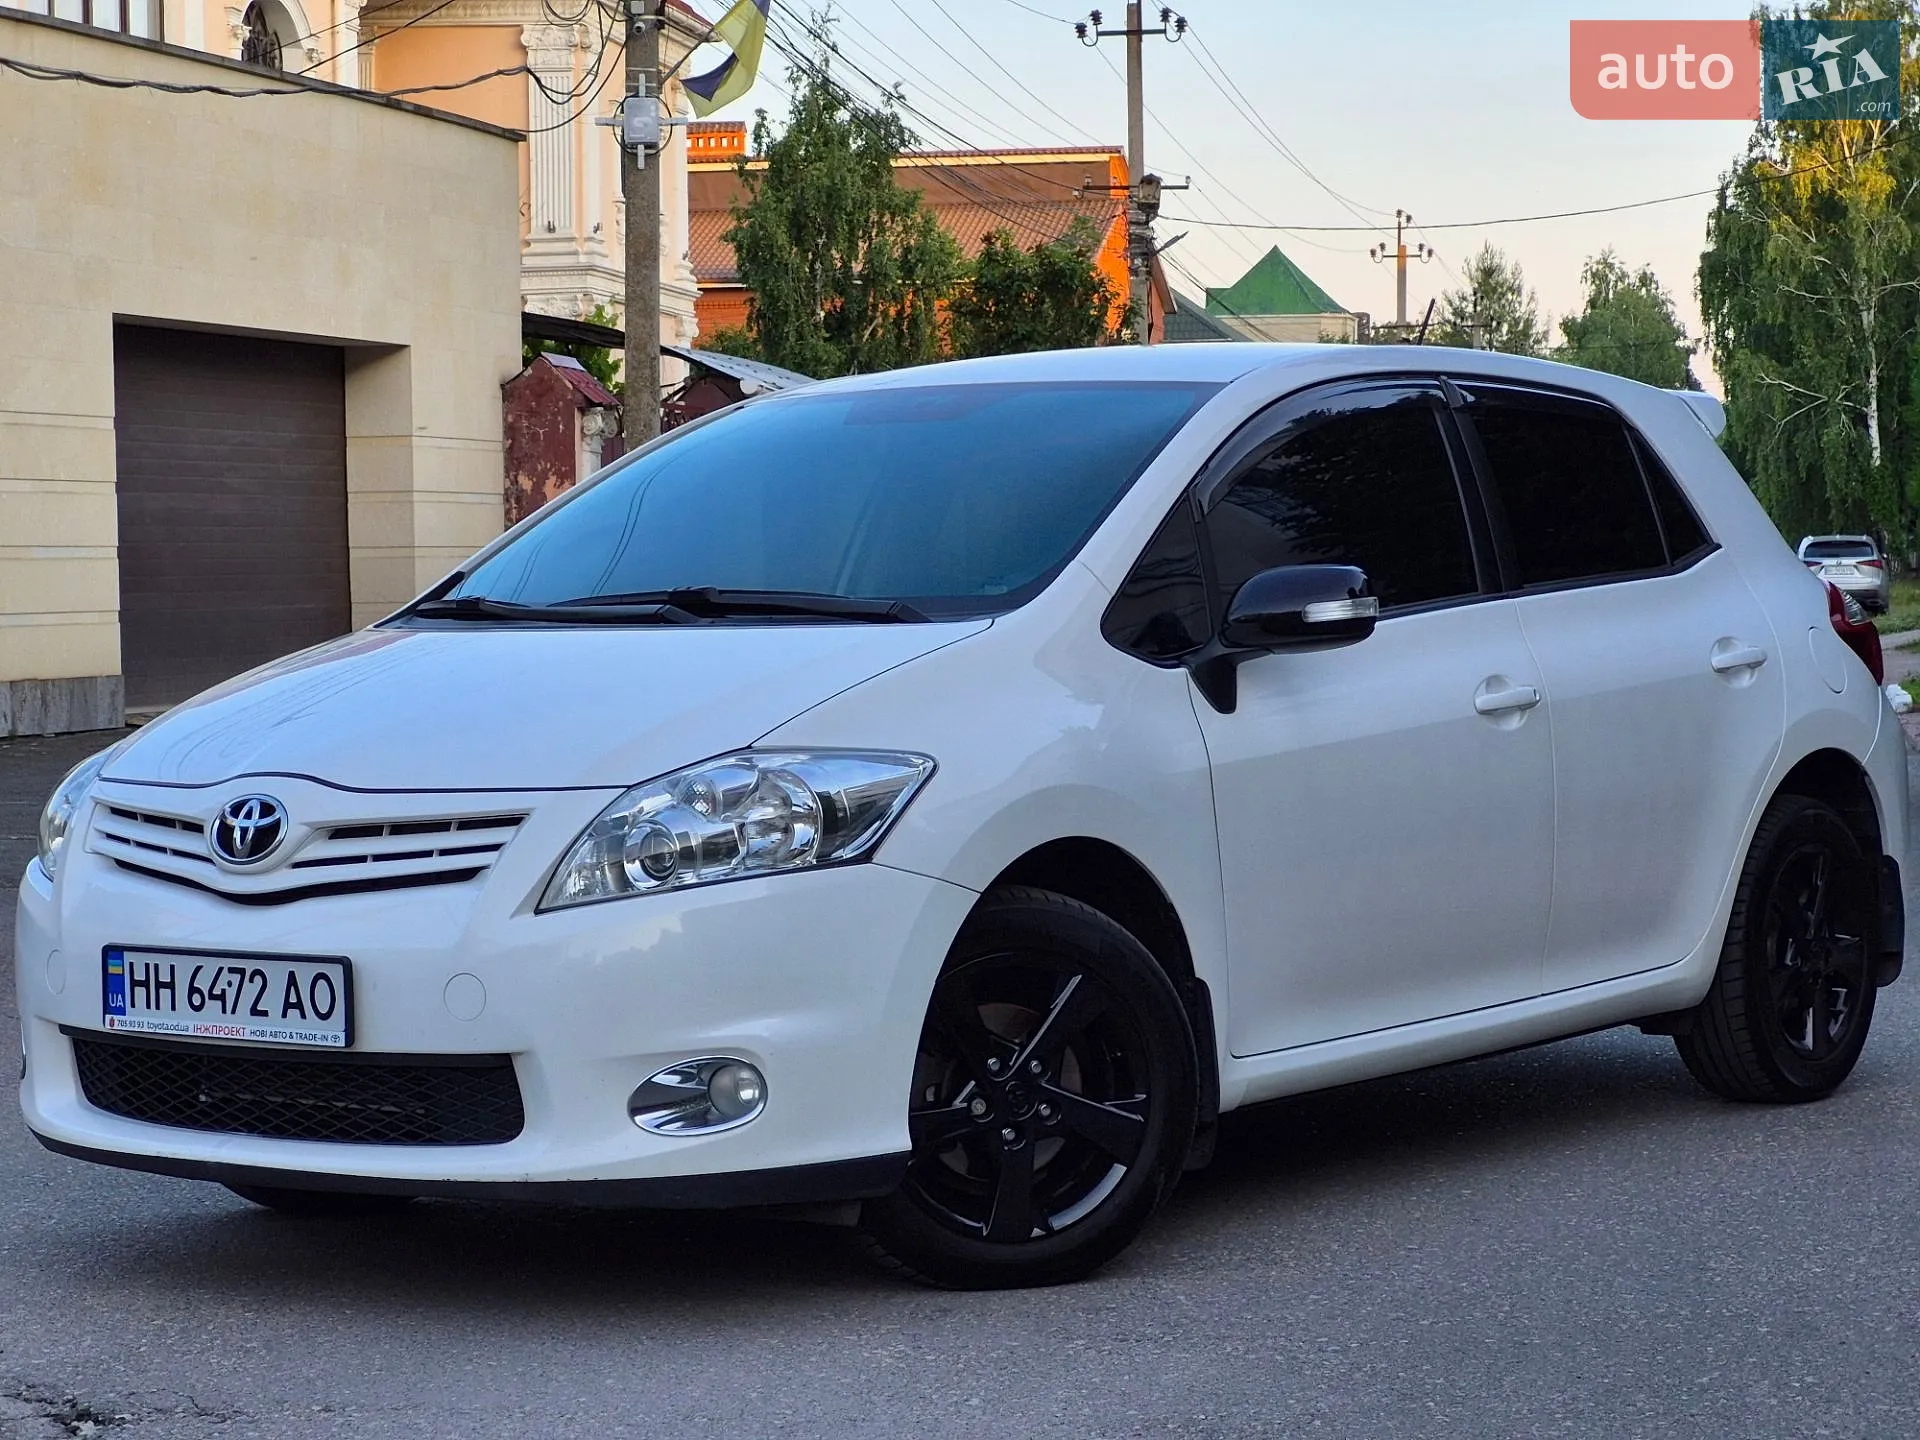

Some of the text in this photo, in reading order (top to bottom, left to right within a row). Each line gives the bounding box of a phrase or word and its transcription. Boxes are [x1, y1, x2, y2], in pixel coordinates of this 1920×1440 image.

[129, 961, 336, 1021] HH 6472 AO
[109, 993, 124, 1008] UA
[193, 1023, 246, 1037] ІНЖПРОЕКТ
[268, 1030, 287, 1039] АВТО
[295, 1032, 328, 1042] TRADE-IN
